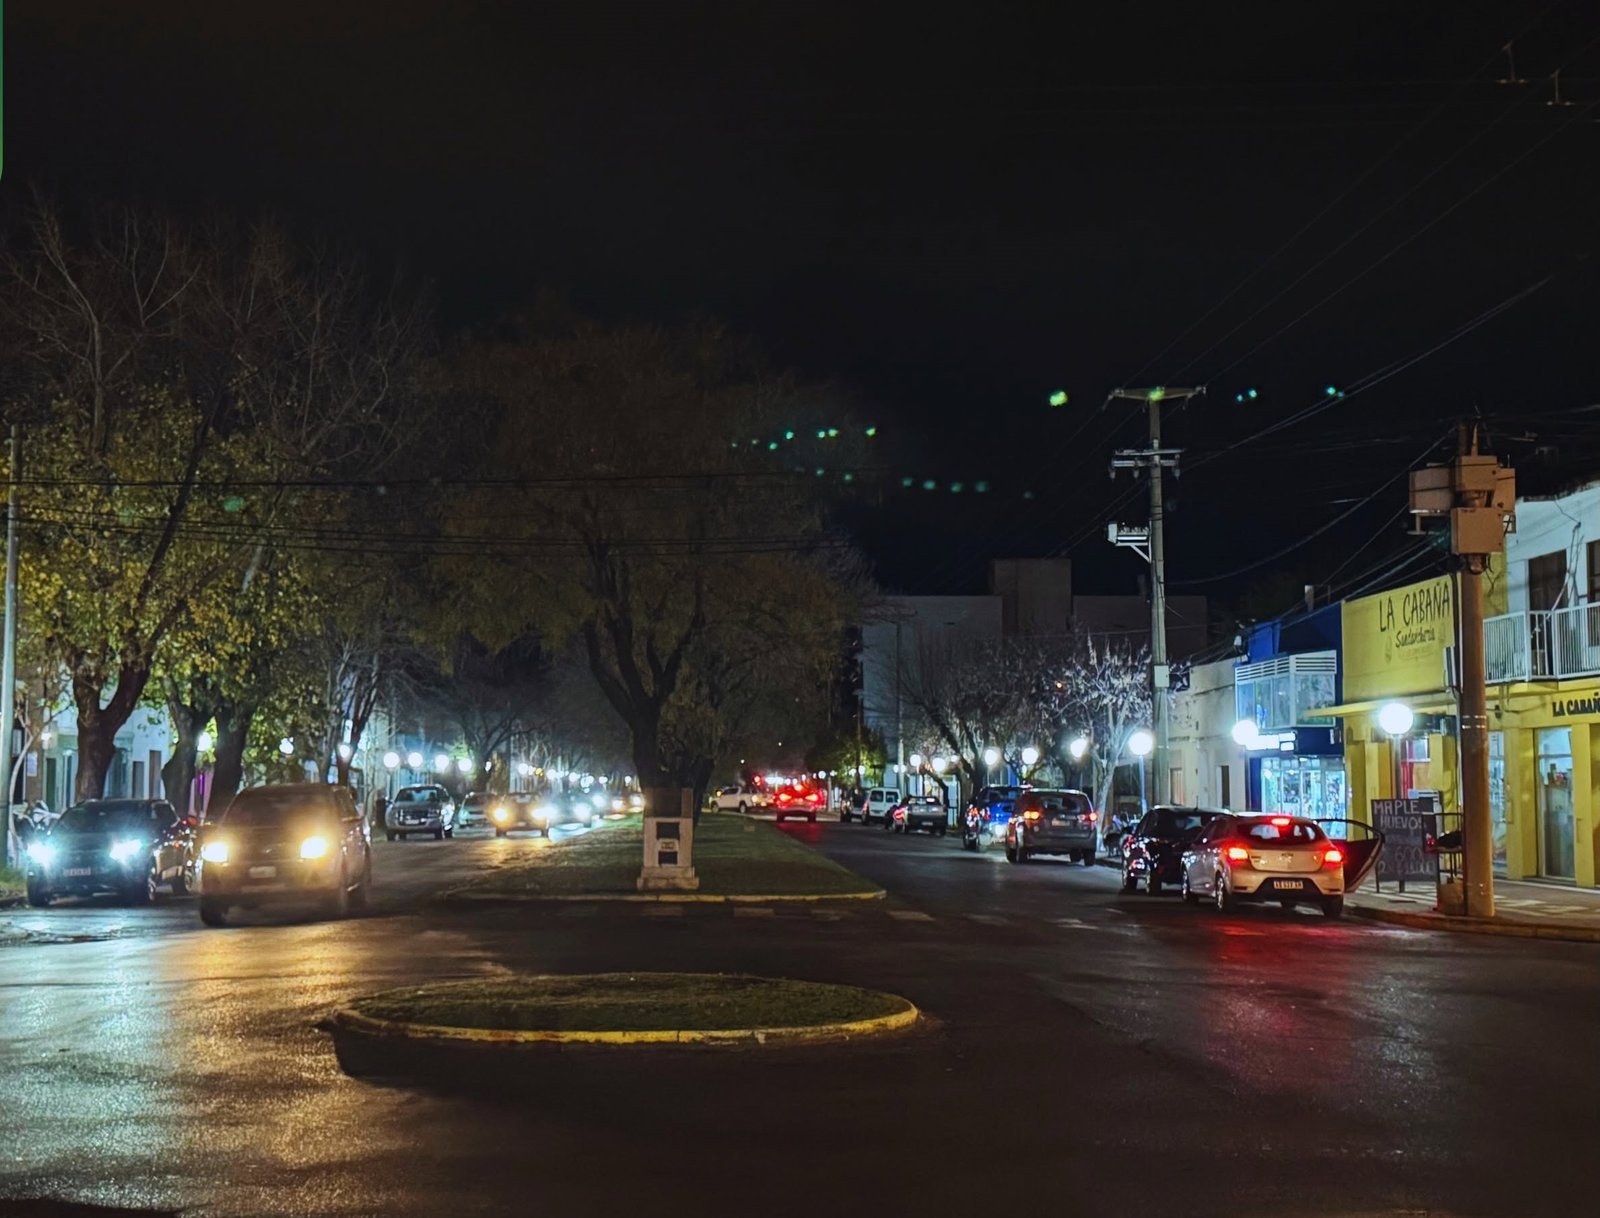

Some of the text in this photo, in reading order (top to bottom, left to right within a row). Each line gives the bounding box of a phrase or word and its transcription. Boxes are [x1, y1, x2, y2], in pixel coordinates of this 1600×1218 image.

[1379, 581, 1449, 632] LA CABAÑA
[1552, 700, 1566, 717] LA
[1373, 800, 1420, 815] MAPLE
